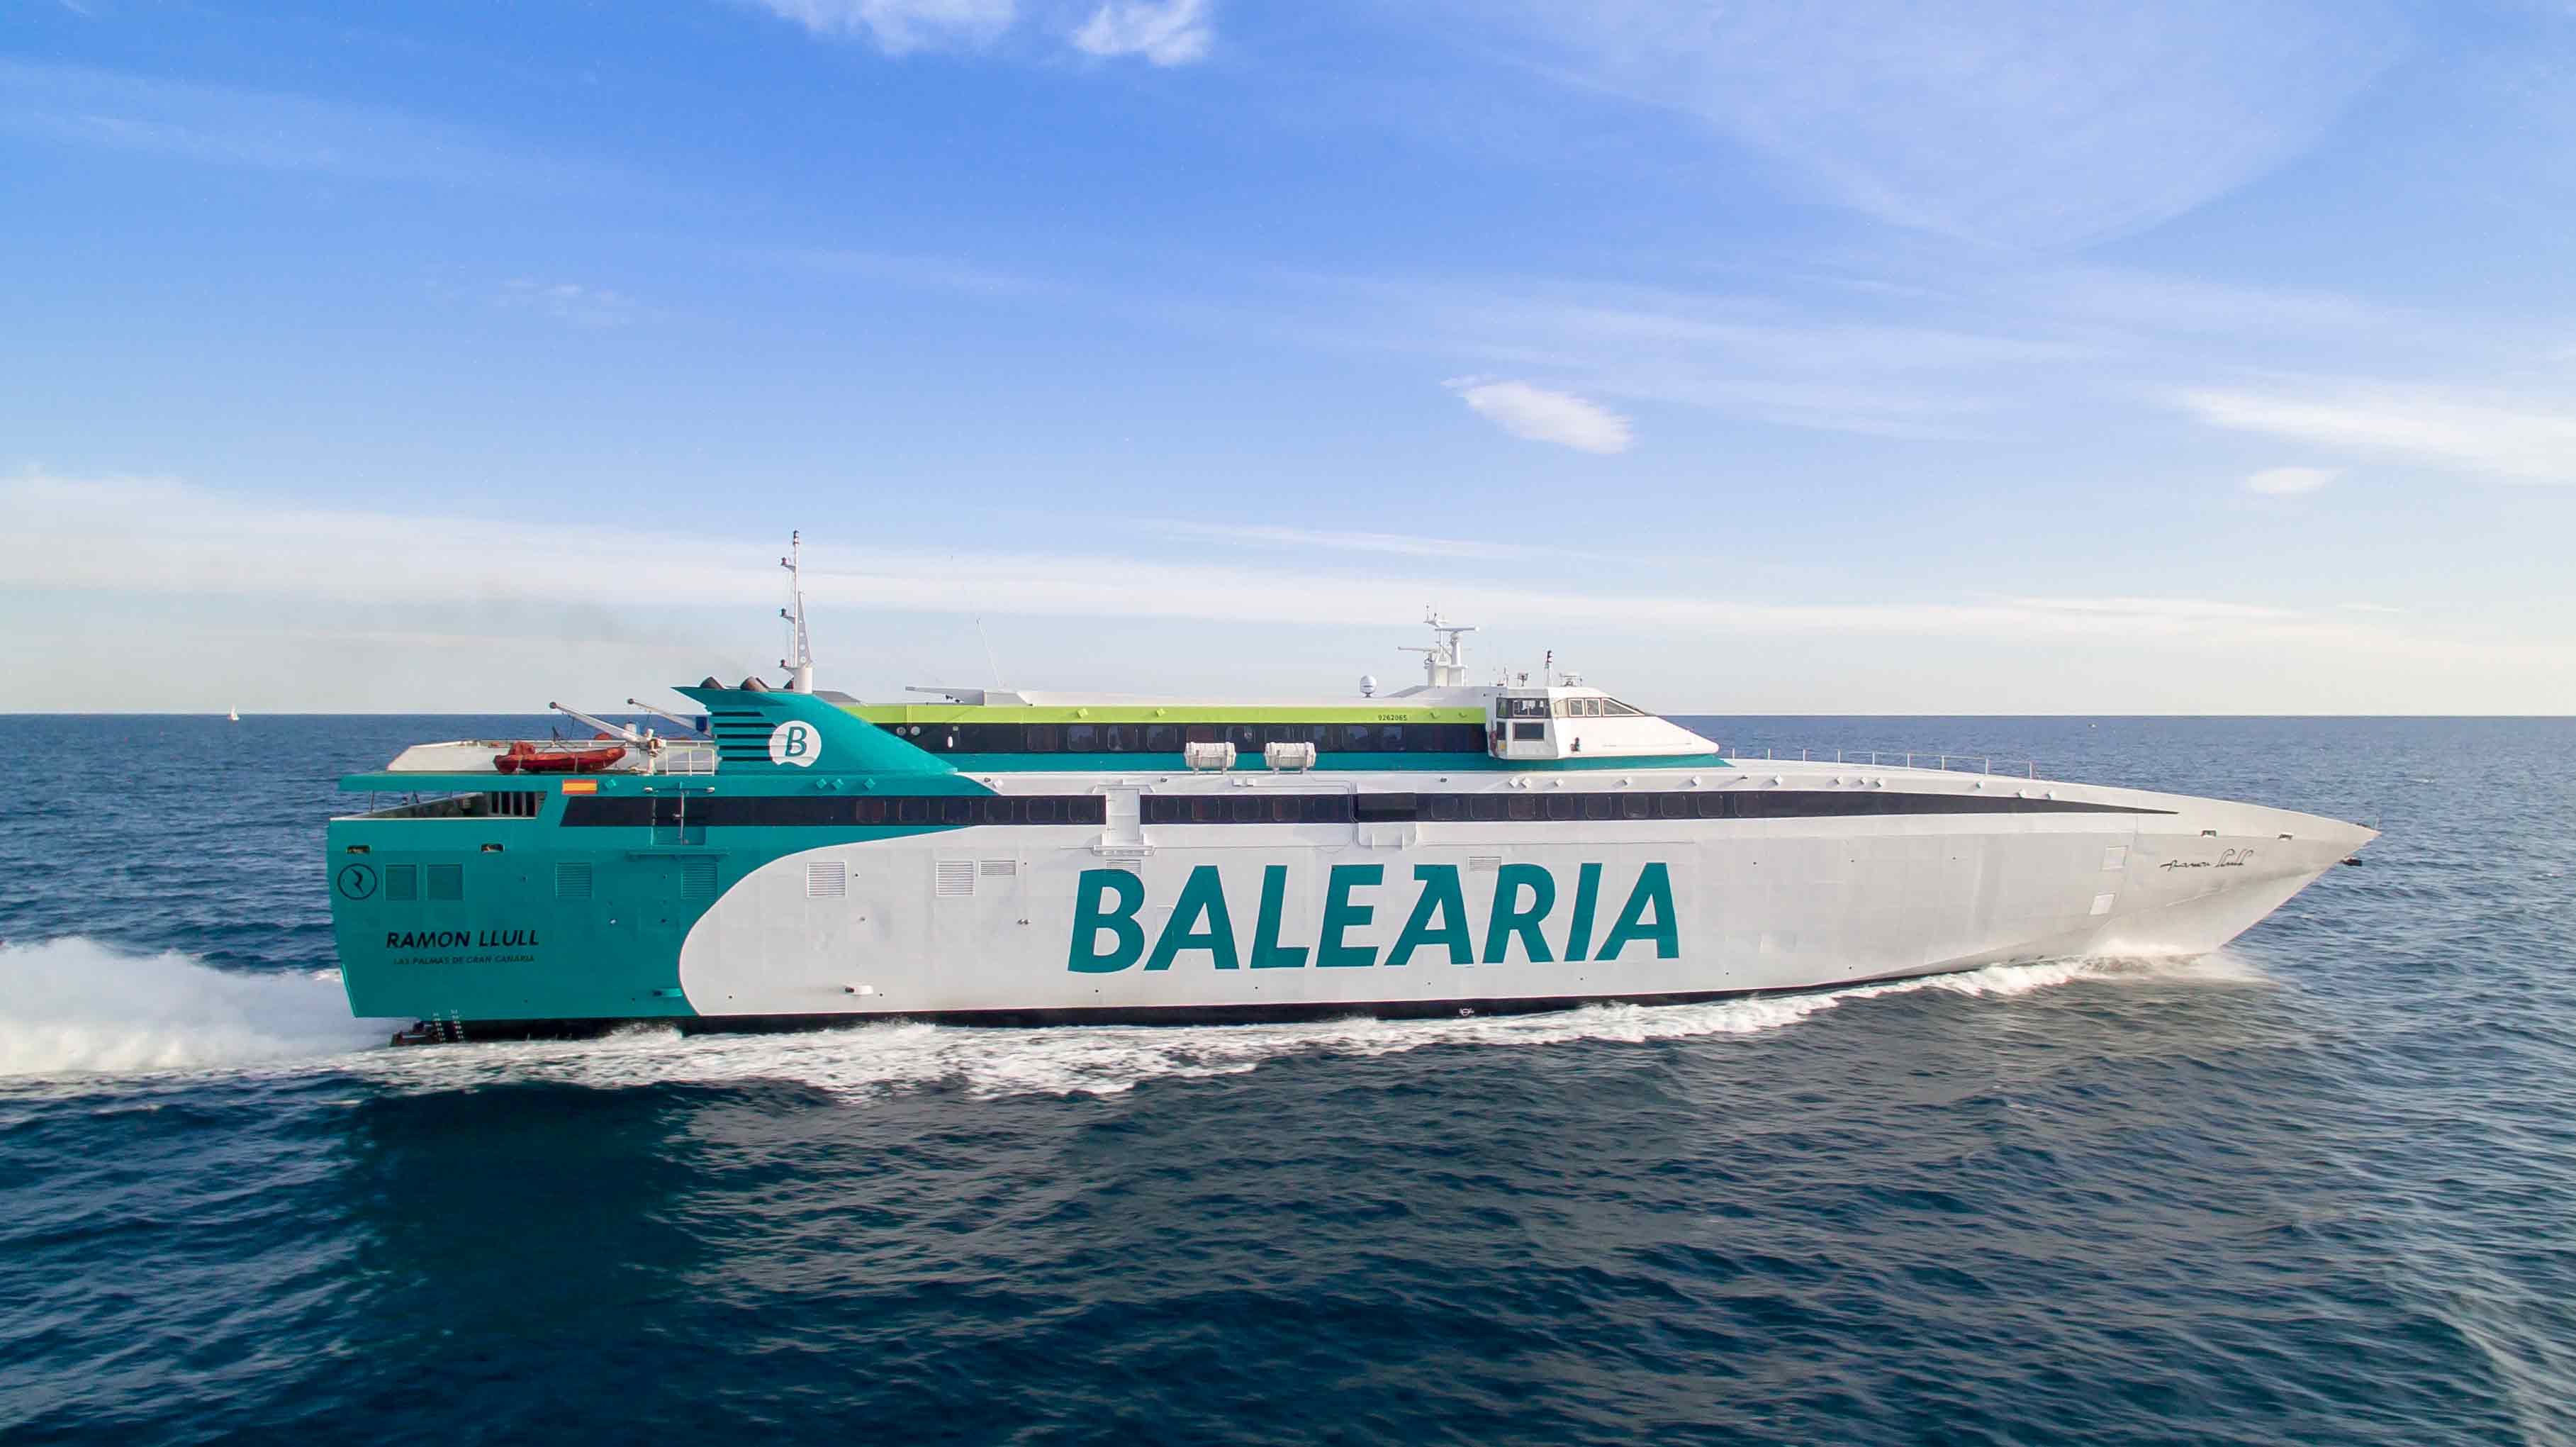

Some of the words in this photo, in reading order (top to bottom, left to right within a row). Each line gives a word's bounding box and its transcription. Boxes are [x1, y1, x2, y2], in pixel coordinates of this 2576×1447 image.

[785, 727, 807, 757] B
[1068, 862, 1679, 973] BALEARIA
[386, 931, 471, 949] RAMON
[478, 929, 539, 948] LLULL
[413, 956, 449, 965] PALMAS
[466, 956, 492, 964] GRAN
[495, 954, 534, 963] CANARIA
